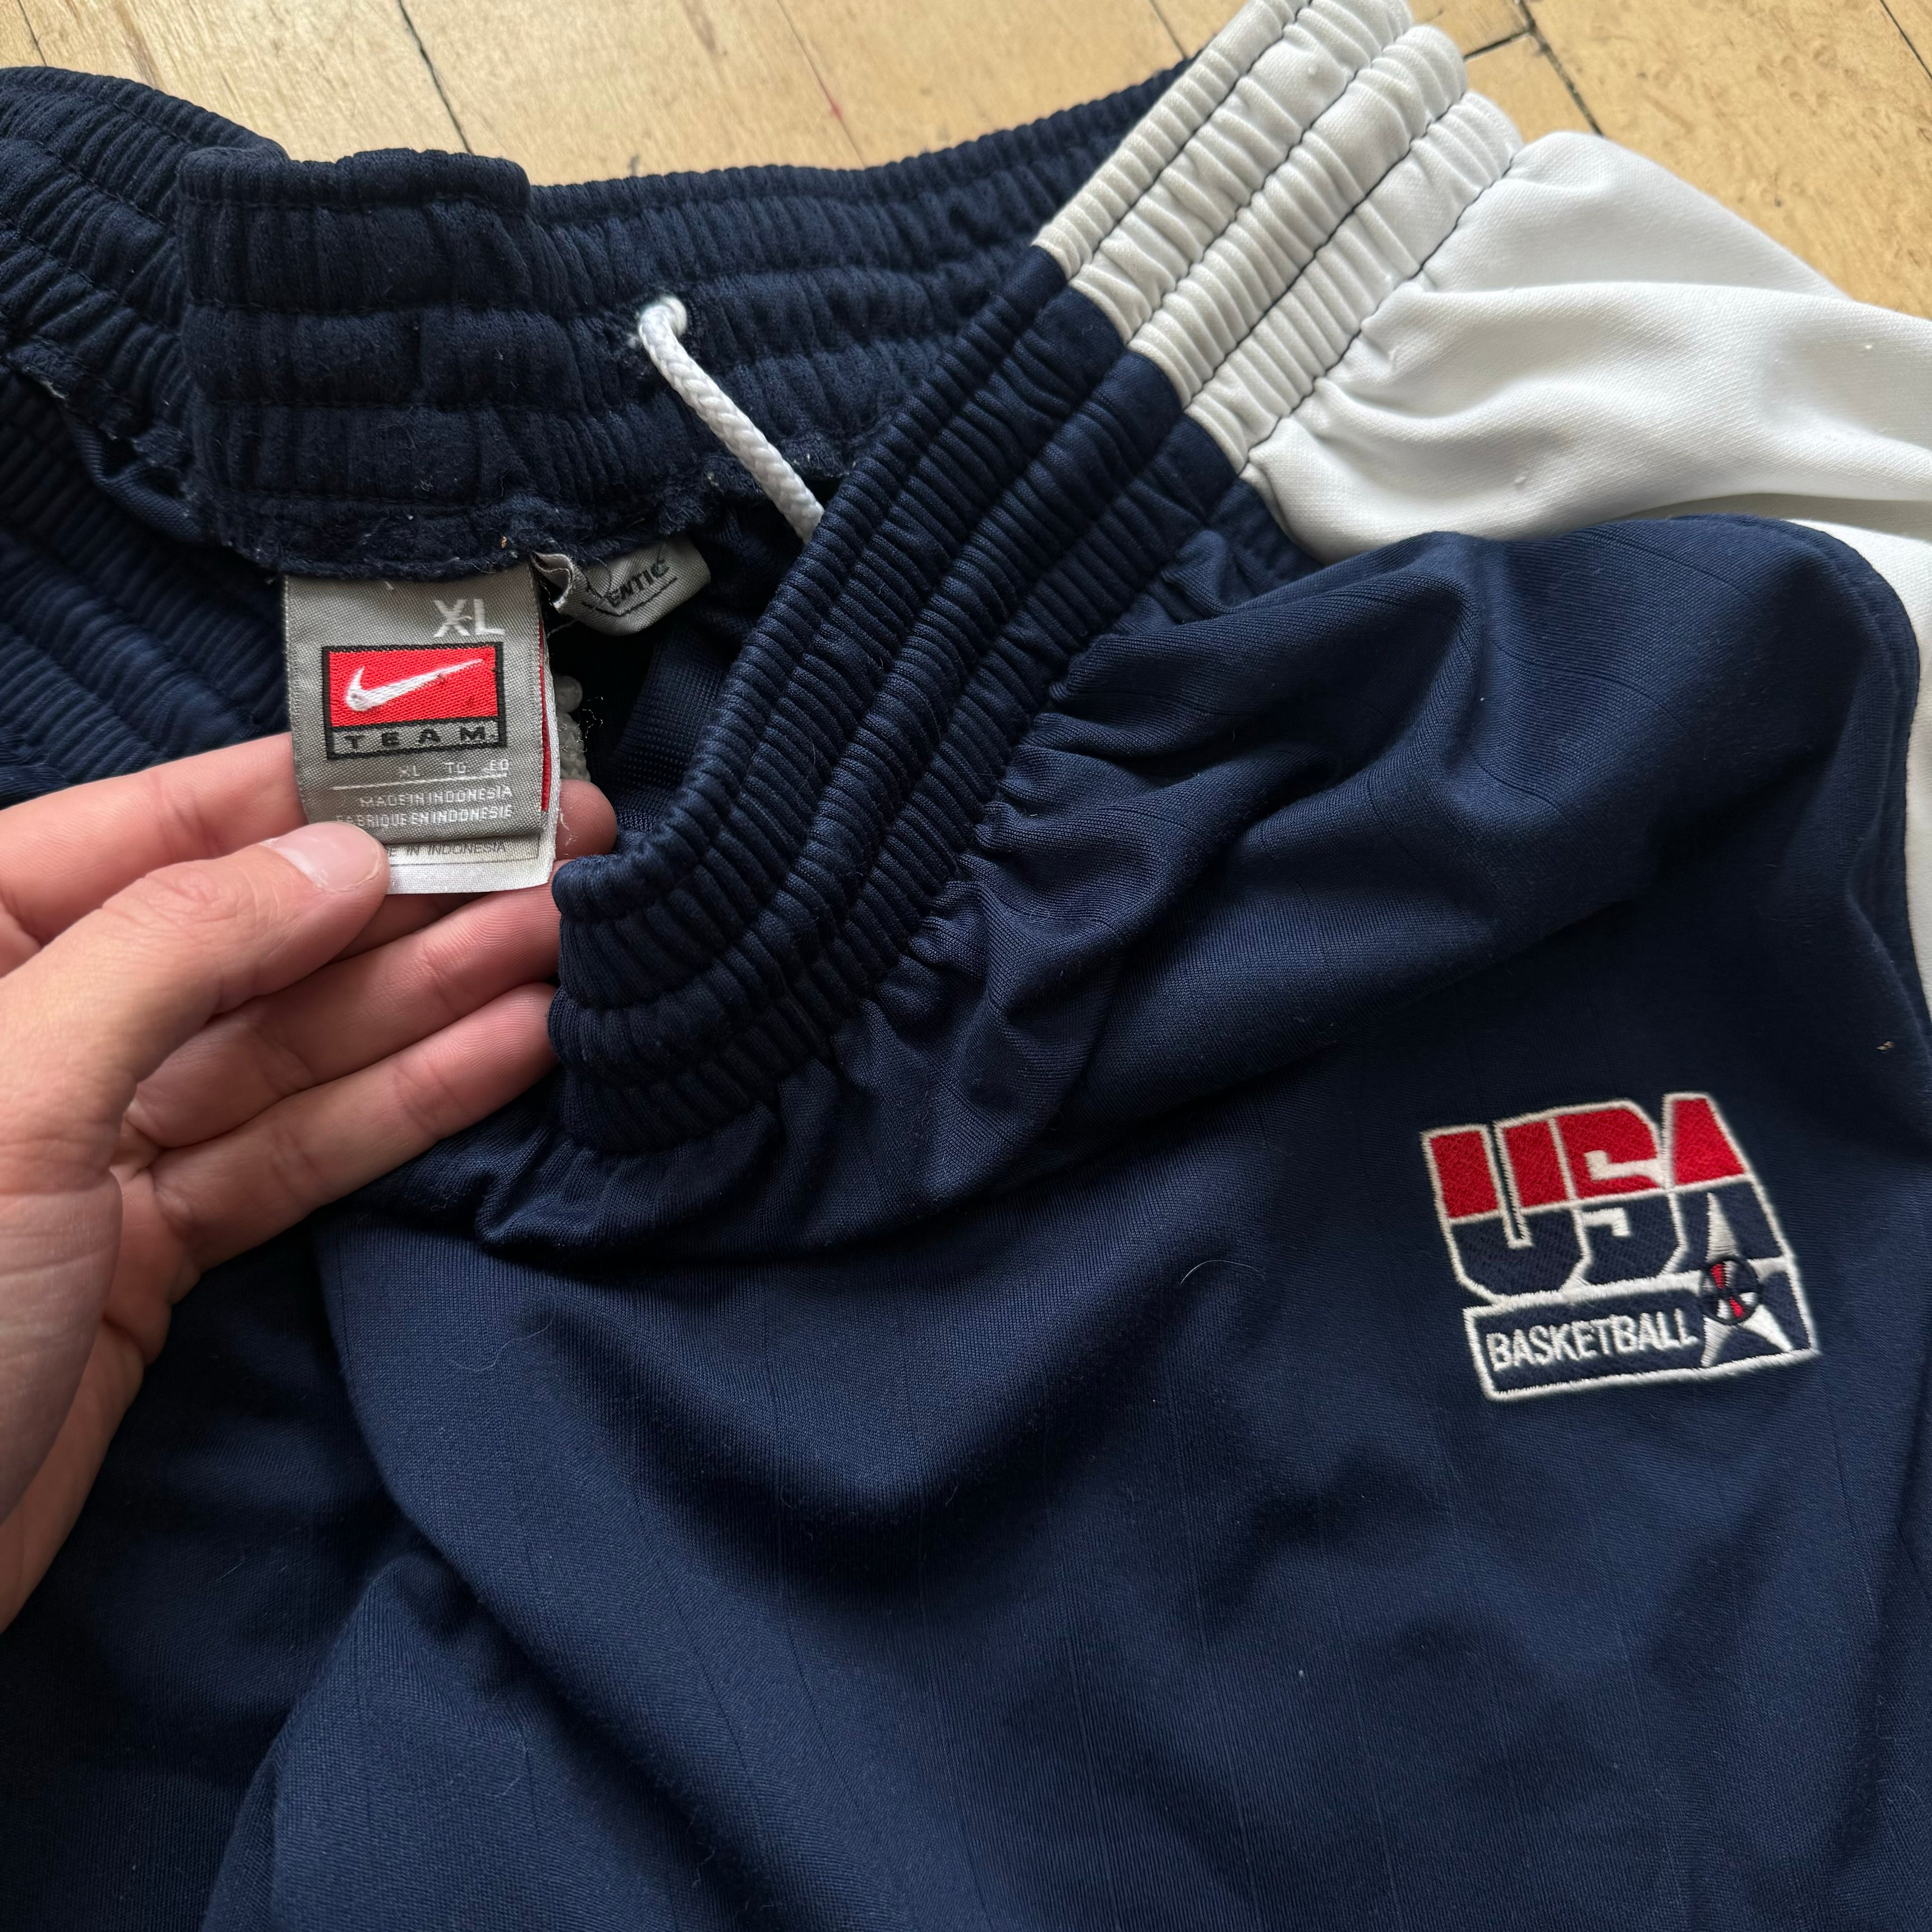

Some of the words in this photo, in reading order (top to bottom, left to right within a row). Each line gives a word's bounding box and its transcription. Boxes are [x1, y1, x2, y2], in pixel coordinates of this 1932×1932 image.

[433, 598, 505, 637] XL
[344, 726, 486, 749] TEAM
[444, 762, 467, 774] TG
[1421, 1092, 1795, 1305] USA
[1485, 1308, 1700, 1372] BASKETBALL
